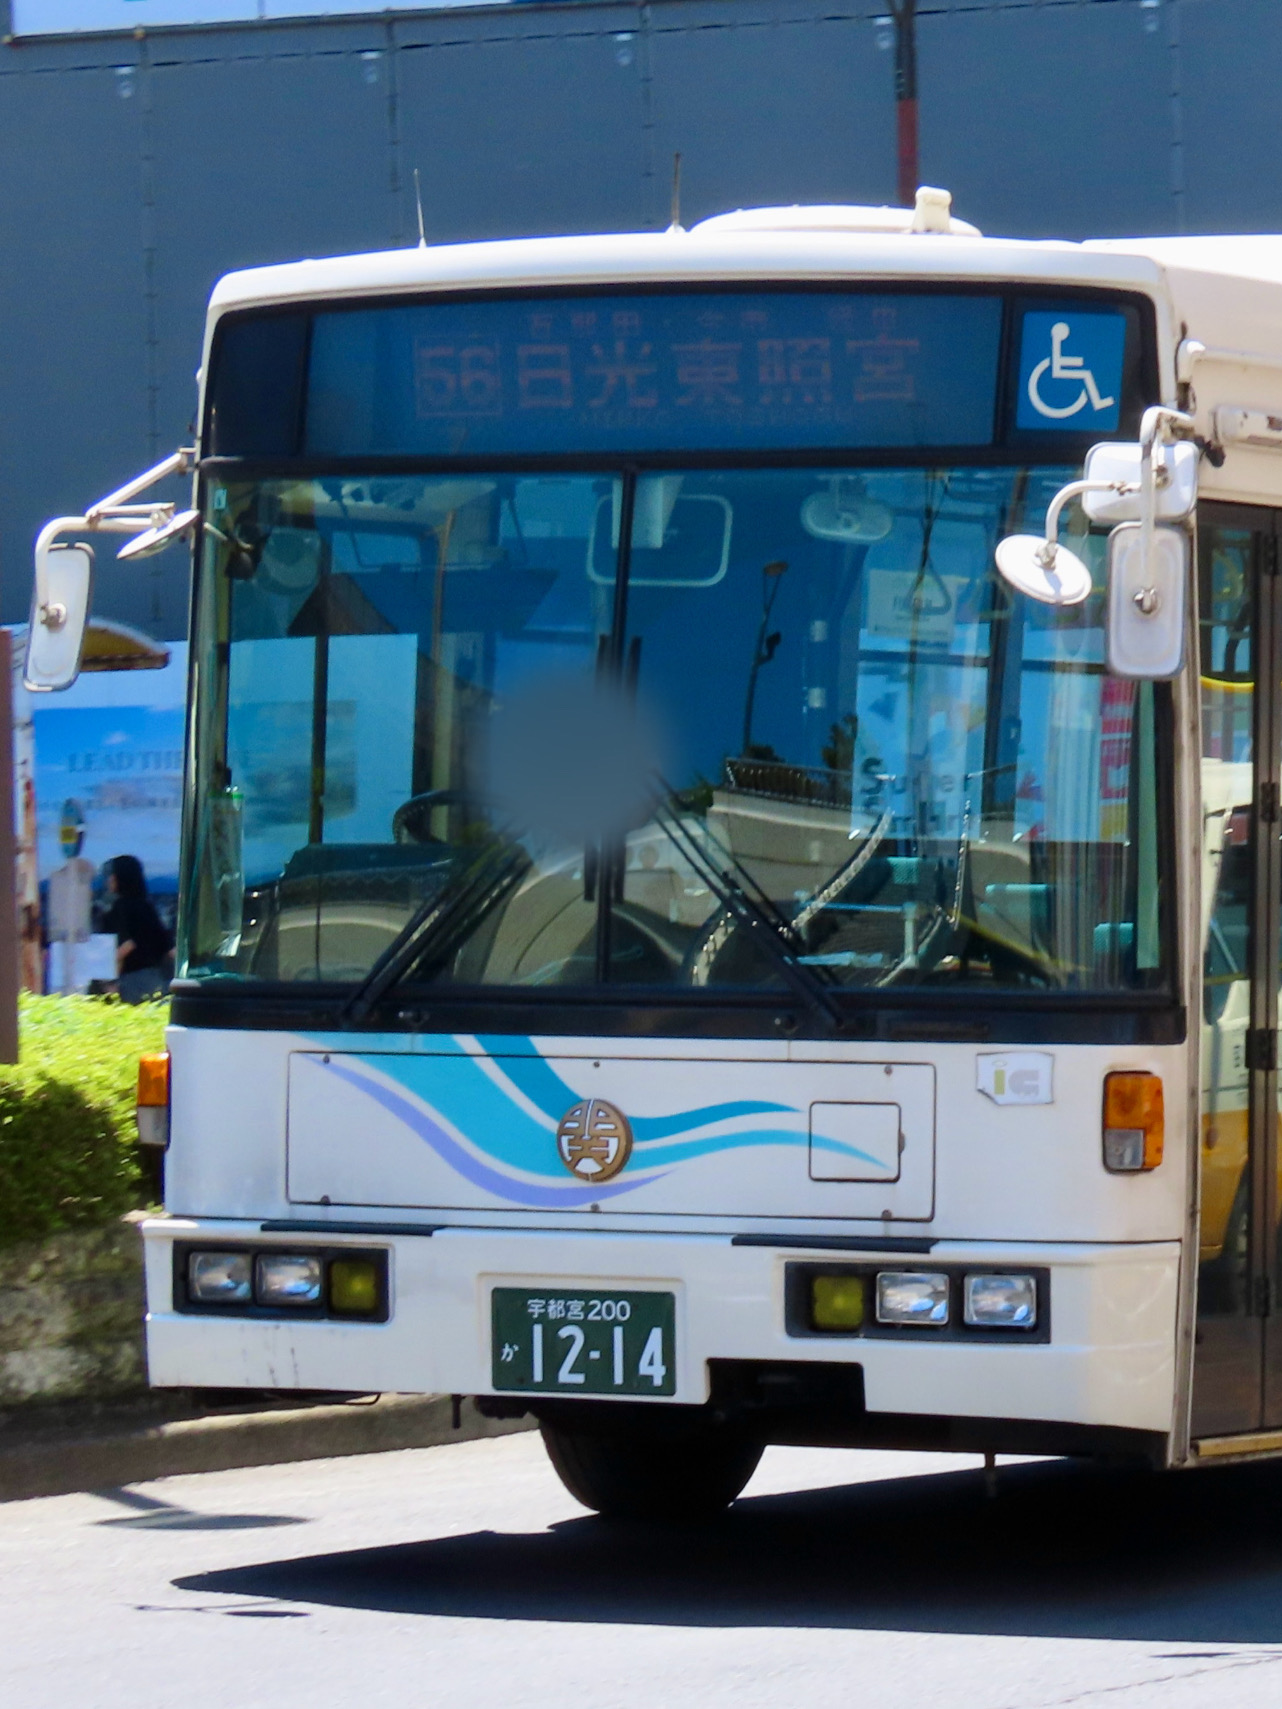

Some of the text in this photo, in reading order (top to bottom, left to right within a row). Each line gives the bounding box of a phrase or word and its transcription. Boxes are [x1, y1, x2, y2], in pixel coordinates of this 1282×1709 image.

[419, 335, 921, 409] 56 日光東照宮
[531, 1323, 667, 1387] 12-14
